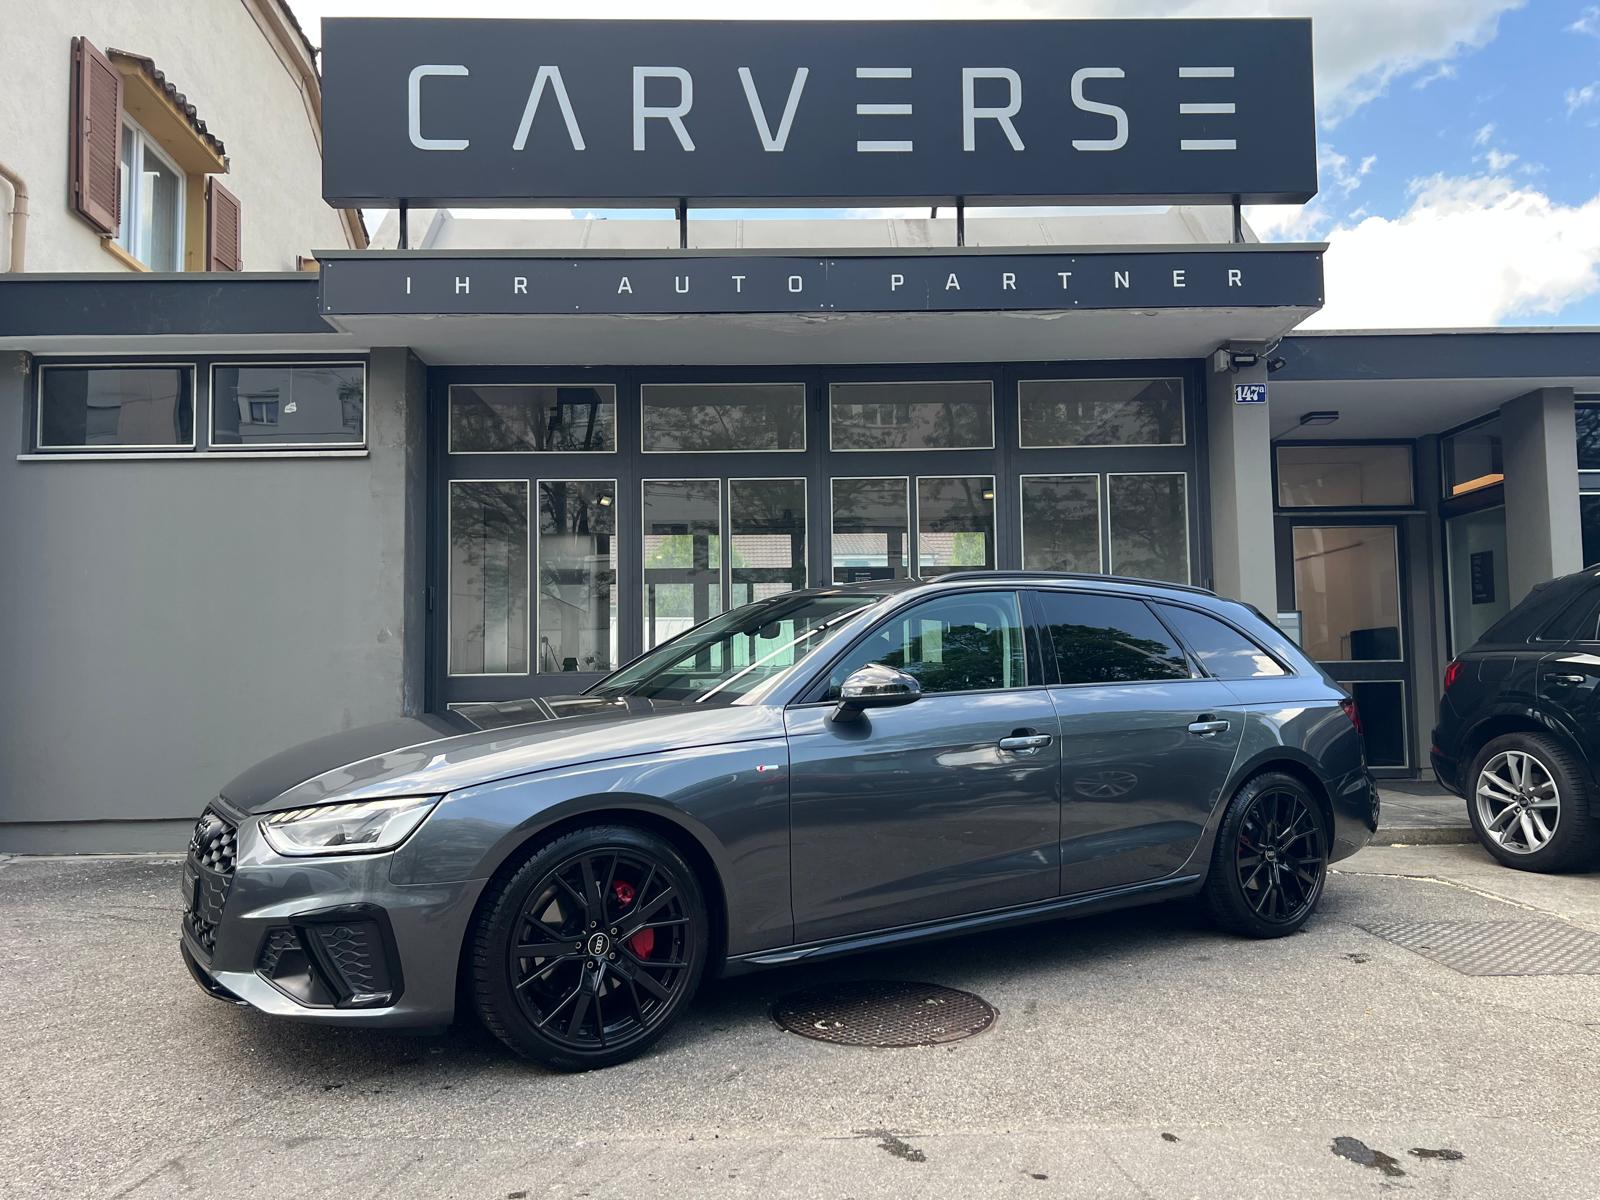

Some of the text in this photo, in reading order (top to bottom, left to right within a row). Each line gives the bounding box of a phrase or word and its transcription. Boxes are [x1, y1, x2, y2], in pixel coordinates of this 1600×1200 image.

[408, 64, 1237, 152] CARVERSE
[406, 269, 1242, 295] IHR AUTO PARTNER
